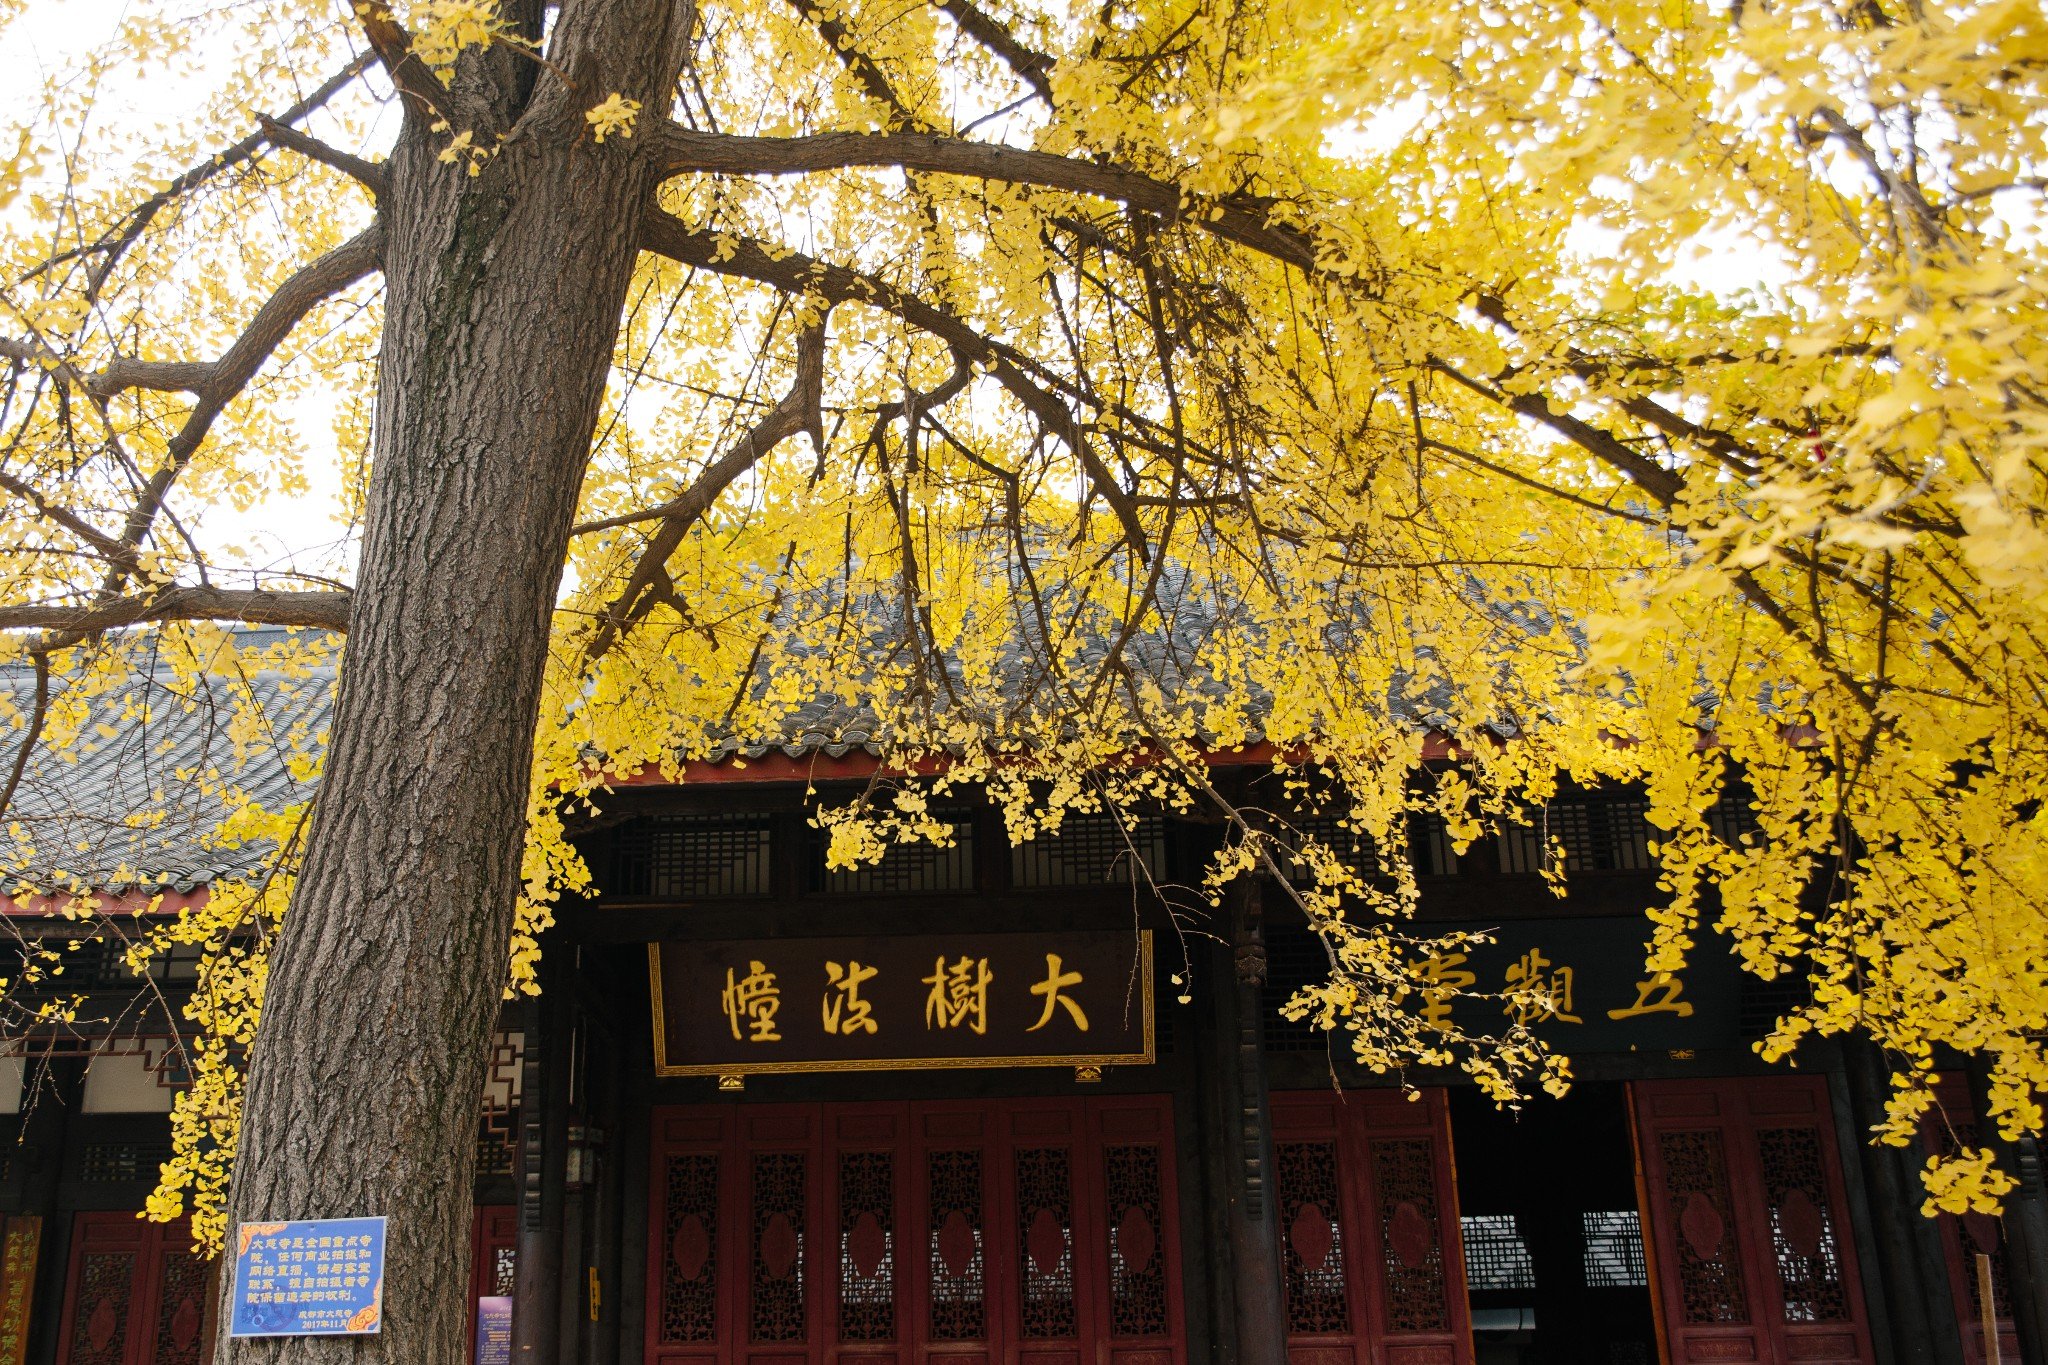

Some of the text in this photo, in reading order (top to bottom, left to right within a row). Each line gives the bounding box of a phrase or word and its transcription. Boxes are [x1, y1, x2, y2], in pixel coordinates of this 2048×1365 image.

[251, 1234, 373, 1250] 大慈寺是全国重点寺
